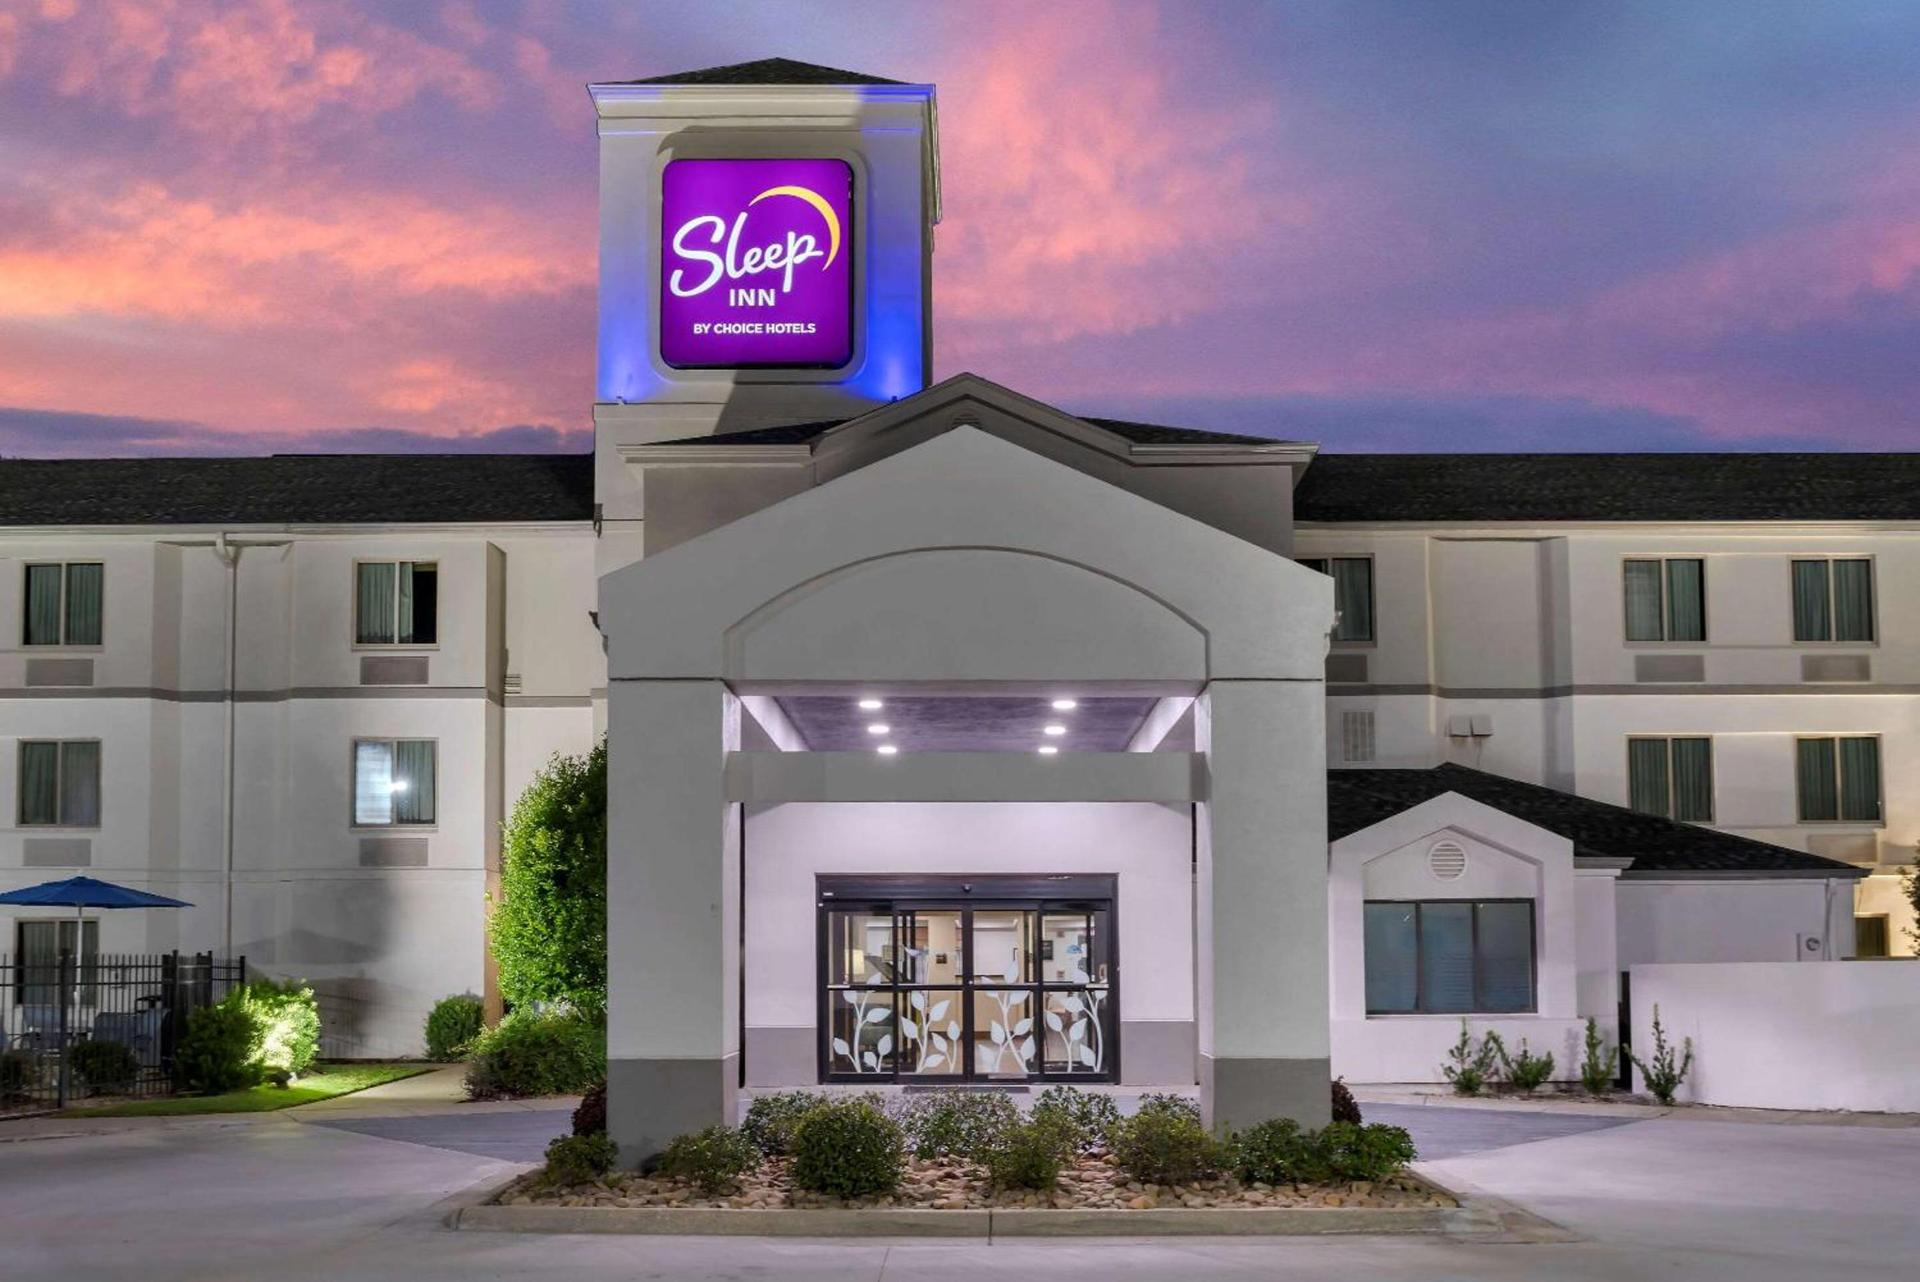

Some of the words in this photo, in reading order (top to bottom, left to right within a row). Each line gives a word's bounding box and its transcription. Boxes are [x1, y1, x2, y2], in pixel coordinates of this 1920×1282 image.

[669, 211, 824, 298] Sleep
[729, 288, 776, 307] INN
[693, 322, 711, 335] BY
[713, 322, 763, 335] CHOICE
[765, 322, 817, 335] HOTELS
